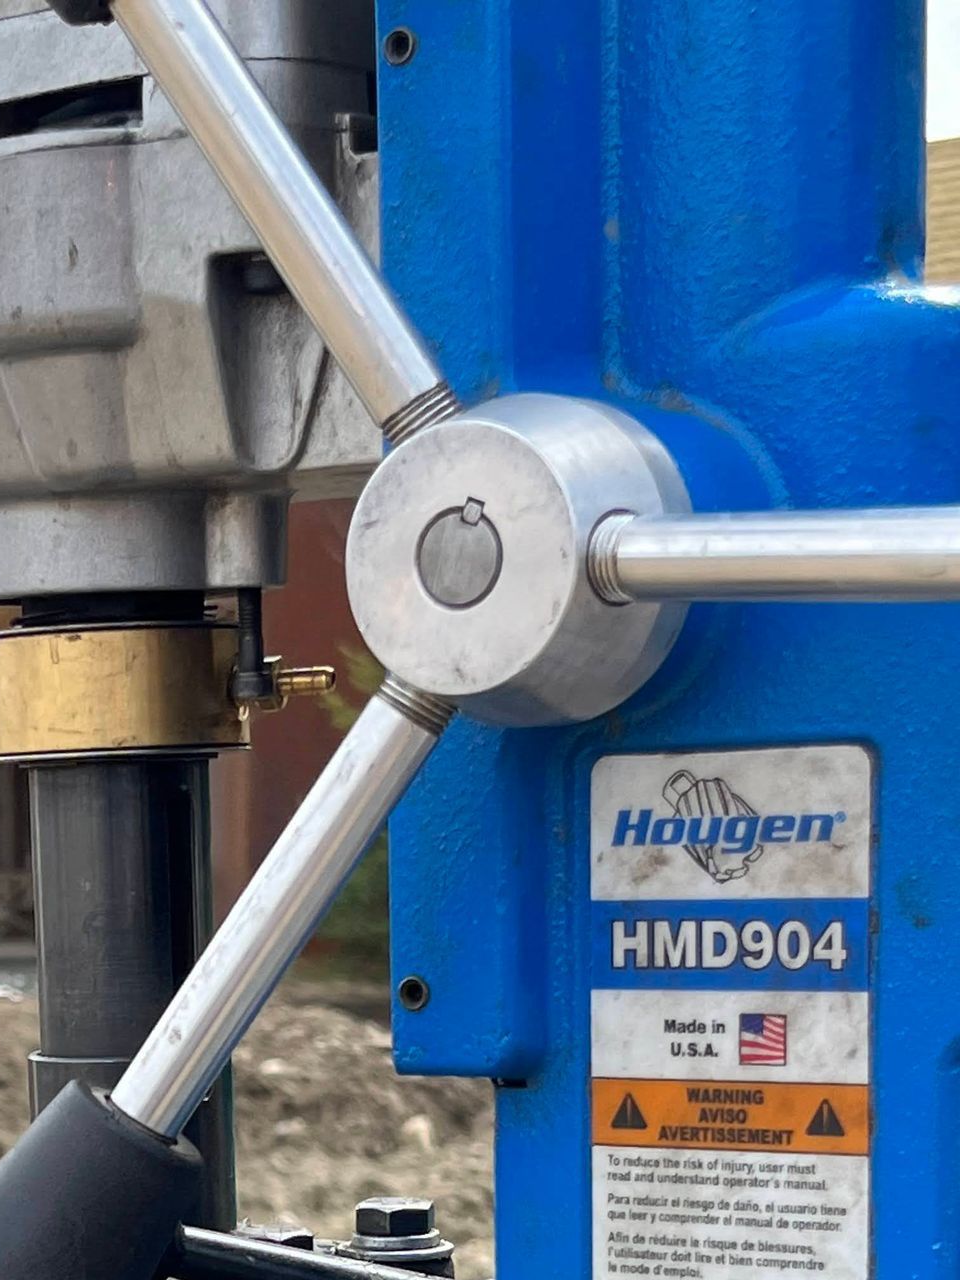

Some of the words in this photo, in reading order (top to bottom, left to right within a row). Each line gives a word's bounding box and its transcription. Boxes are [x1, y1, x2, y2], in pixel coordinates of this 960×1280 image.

[611, 919, 847, 970] HMD904
[664, 1020, 707, 1034] Made
[711, 1020, 725, 1034] in
[670, 1042, 719, 1057] U.S.A.
[687, 1088, 764, 1105] WARNING
[698, 1109, 747, 1124] AVISO
[659, 1126, 794, 1145] AVERTISSEMENT
[608, 1154, 620, 1166] To
[623, 1157, 659, 1168] reduce
[663, 1158, 680, 1168] the
[683, 1158, 702, 1169] risk
[707, 1160, 718, 1170] of
[722, 1161, 754, 1174] injury,
[759, 1163, 784, 1173] user
[787, 1164, 816, 1174] must
[608, 1171, 631, 1182] read
[635, 1173, 654, 1182] and
[657, 1174, 719, 1185] understand
[784, 1180, 828, 1191] manual.
[608, 1193, 630, 1204] Para
[633, 1196, 668, 1206] reducir
[672, 1198, 680, 1207] el
[683, 1199, 714, 1212] riesgo
[718, 1200, 730, 1210] de
[733, 1200, 762, 1213] daño,
[765, 1202, 774, 1212] el
[778, 1204, 817, 1214] usuario
[821, 1205, 846, 1216] tiene
[608, 1212, 625, 1221] que
[629, 1211, 648, 1221] leer
[650, 1214, 656, 1224] y
[659, 1212, 720, 1225] comprender
[723, 1216, 732, 1225] el
[735, 1216, 772, 1228] manual
[776, 1218, 789, 1228] de
[792, 1220, 842, 1232] operador.
[608, 1247, 667, 1260] l'utilisateur
[671, 1251, 691, 1262] doit
[695, 1252, 712, 1263] lire
[716, 1254, 726, 1264] et
[729, 1254, 752, 1265] bien
[756, 1259, 824, 1271] comprendre
[608, 1262, 616, 1272] le
[620, 1264, 649, 1274] mode
[653, 1265, 703, 1278] d'emploi.
